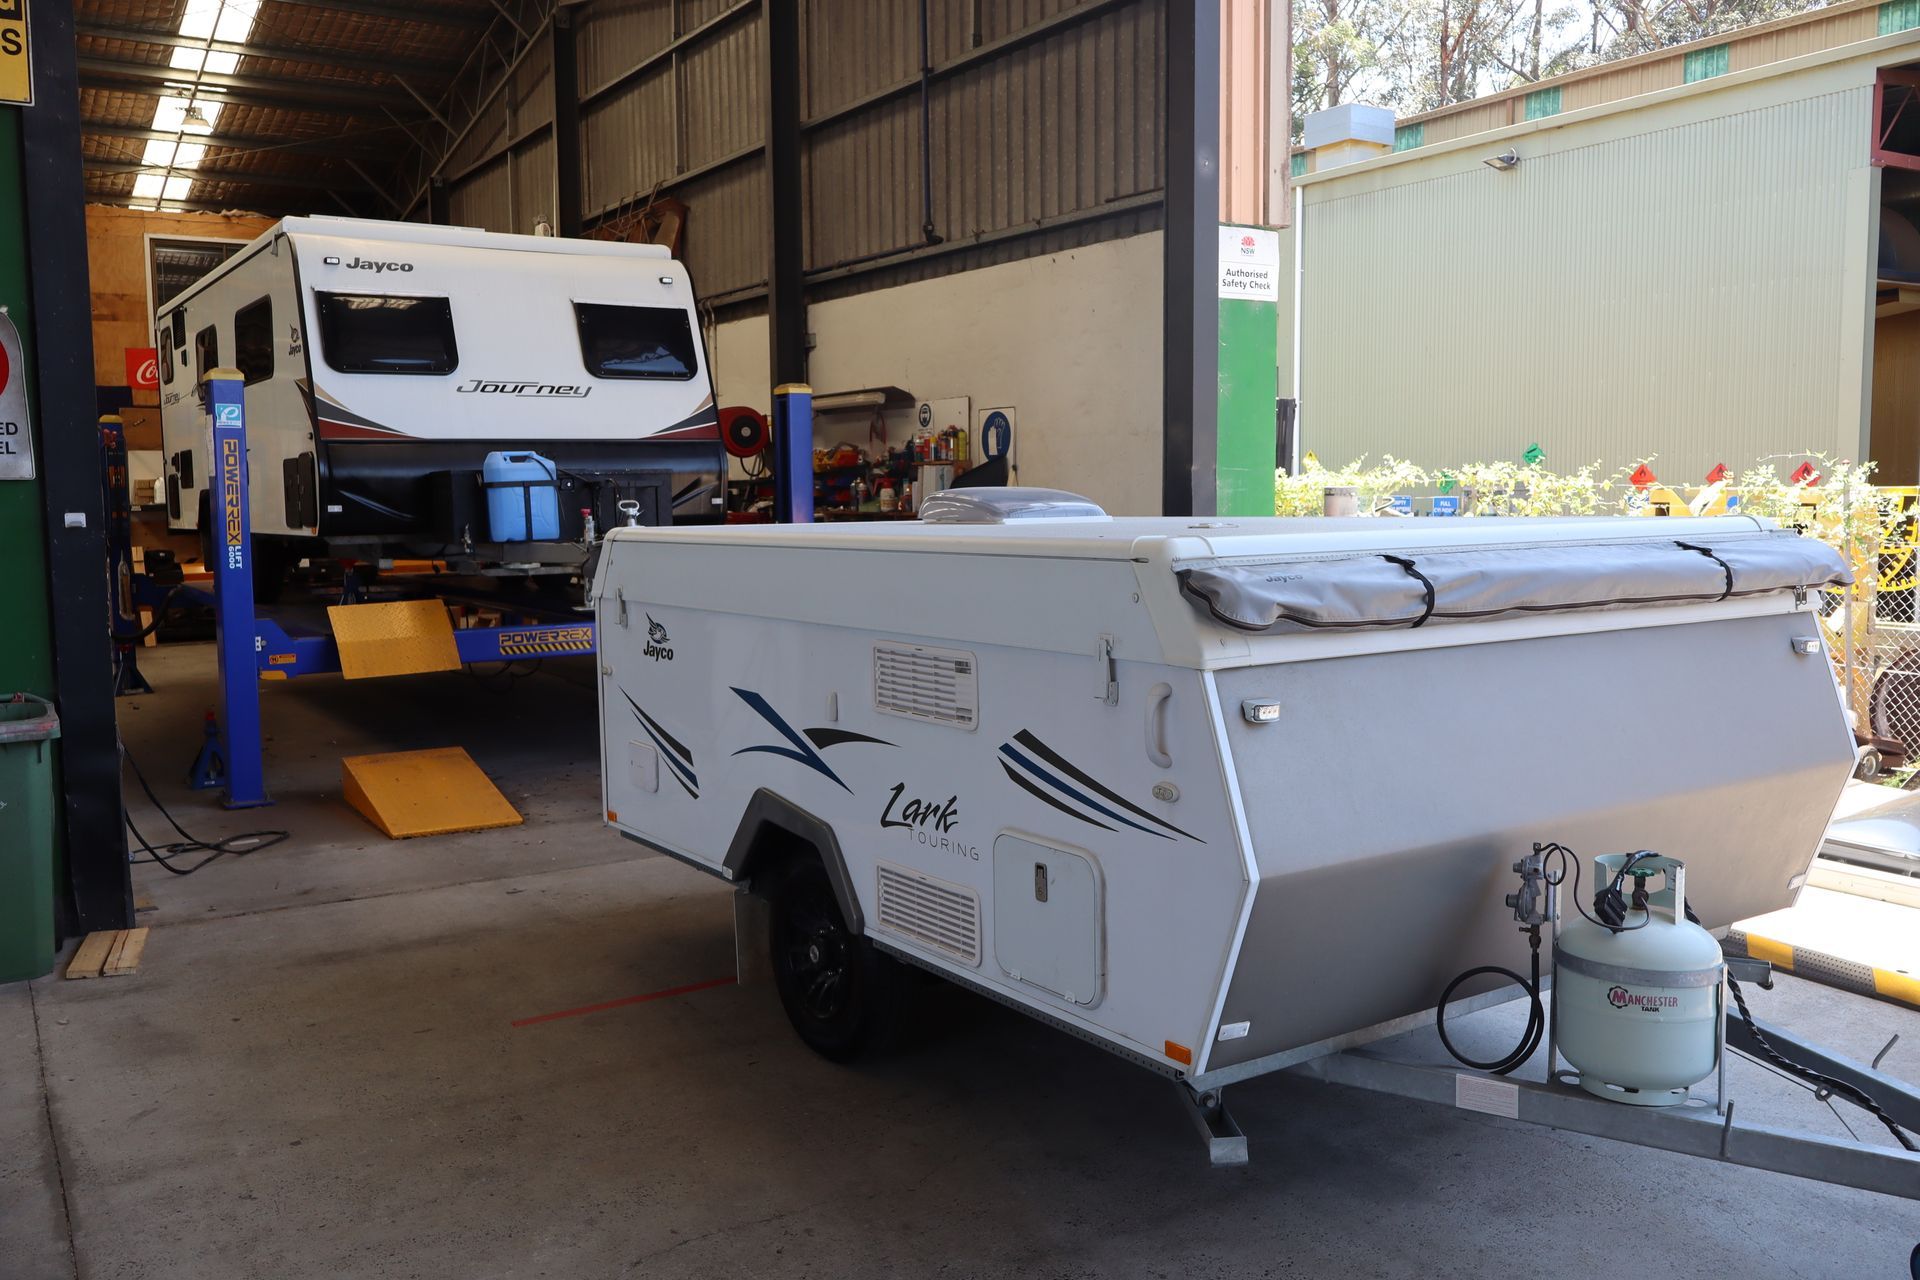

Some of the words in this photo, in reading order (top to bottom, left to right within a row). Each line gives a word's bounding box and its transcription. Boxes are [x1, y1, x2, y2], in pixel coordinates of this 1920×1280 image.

[346, 257, 414, 273] Jayco
[1226, 268, 1268, 279] Authorised
[1222, 279, 1247, 290] Safety
[1249, 280, 1271, 290] Check
[456, 379, 592, 398] Journey
[224, 441, 241, 544] POWERREX
[234, 546, 243, 569] LIFT
[500, 628, 592, 645] POWERREX
[643, 640, 674, 662] Jayco
[880, 782, 959, 834] Lark
[907, 827, 979, 861] TOURING
[1612, 990, 1678, 1007] MANCHESTER
